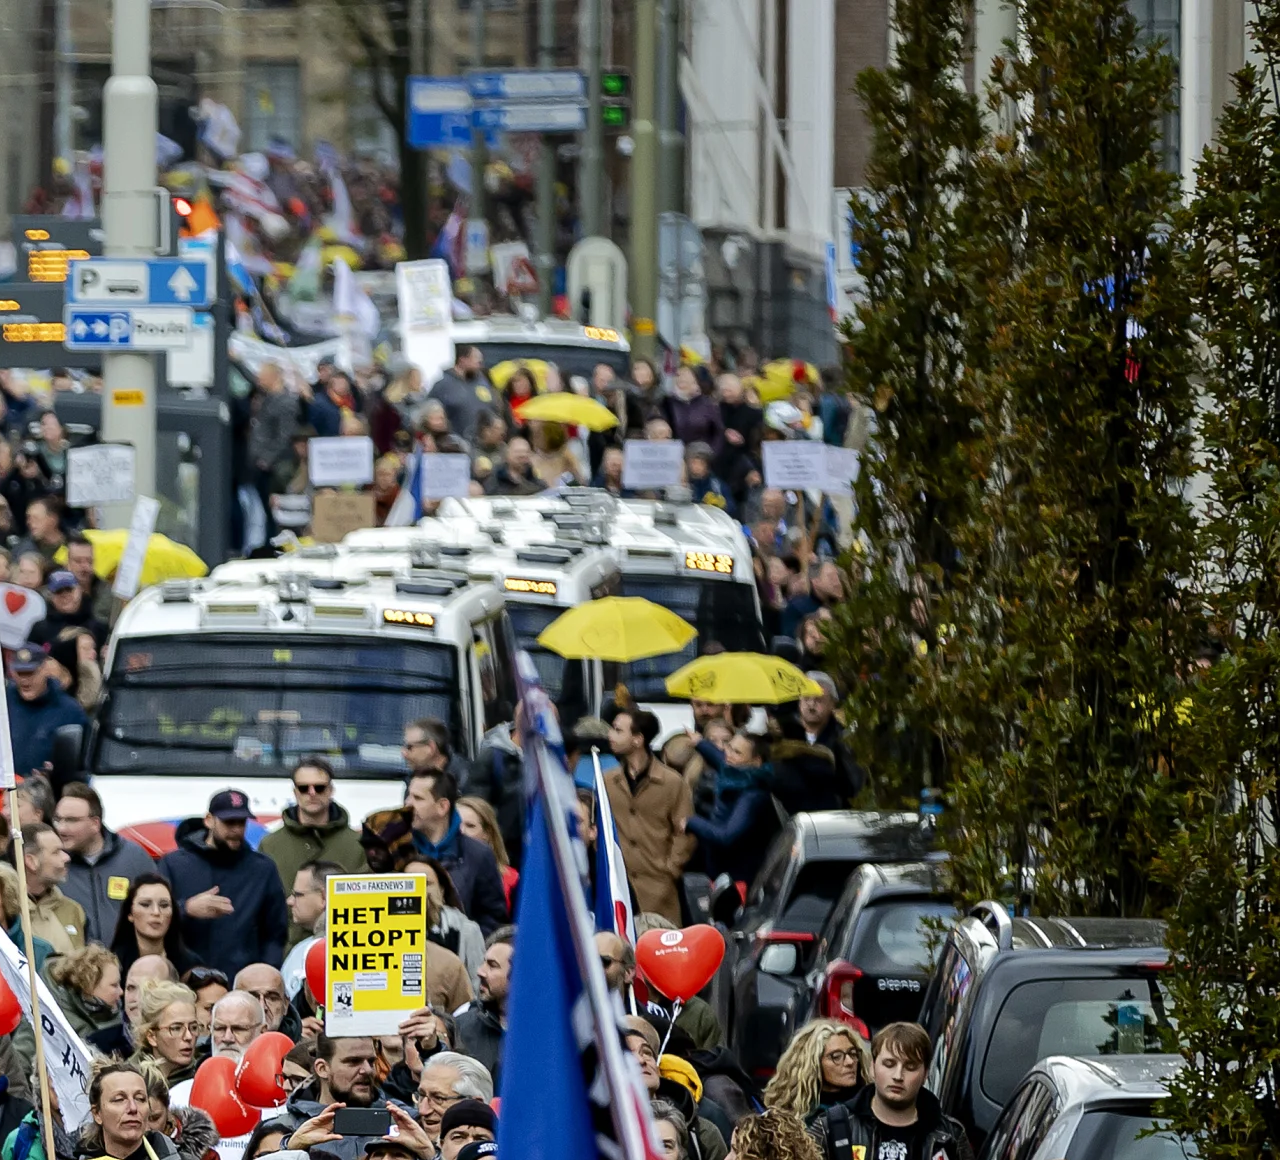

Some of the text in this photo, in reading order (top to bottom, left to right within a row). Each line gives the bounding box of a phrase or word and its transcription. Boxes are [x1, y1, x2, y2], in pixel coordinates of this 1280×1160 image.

[367, 880, 404, 891] FAKENEWS
[332, 907, 385, 925] HET
[332, 929, 421, 948] KLOPT
[332, 953, 399, 971] NIET.
